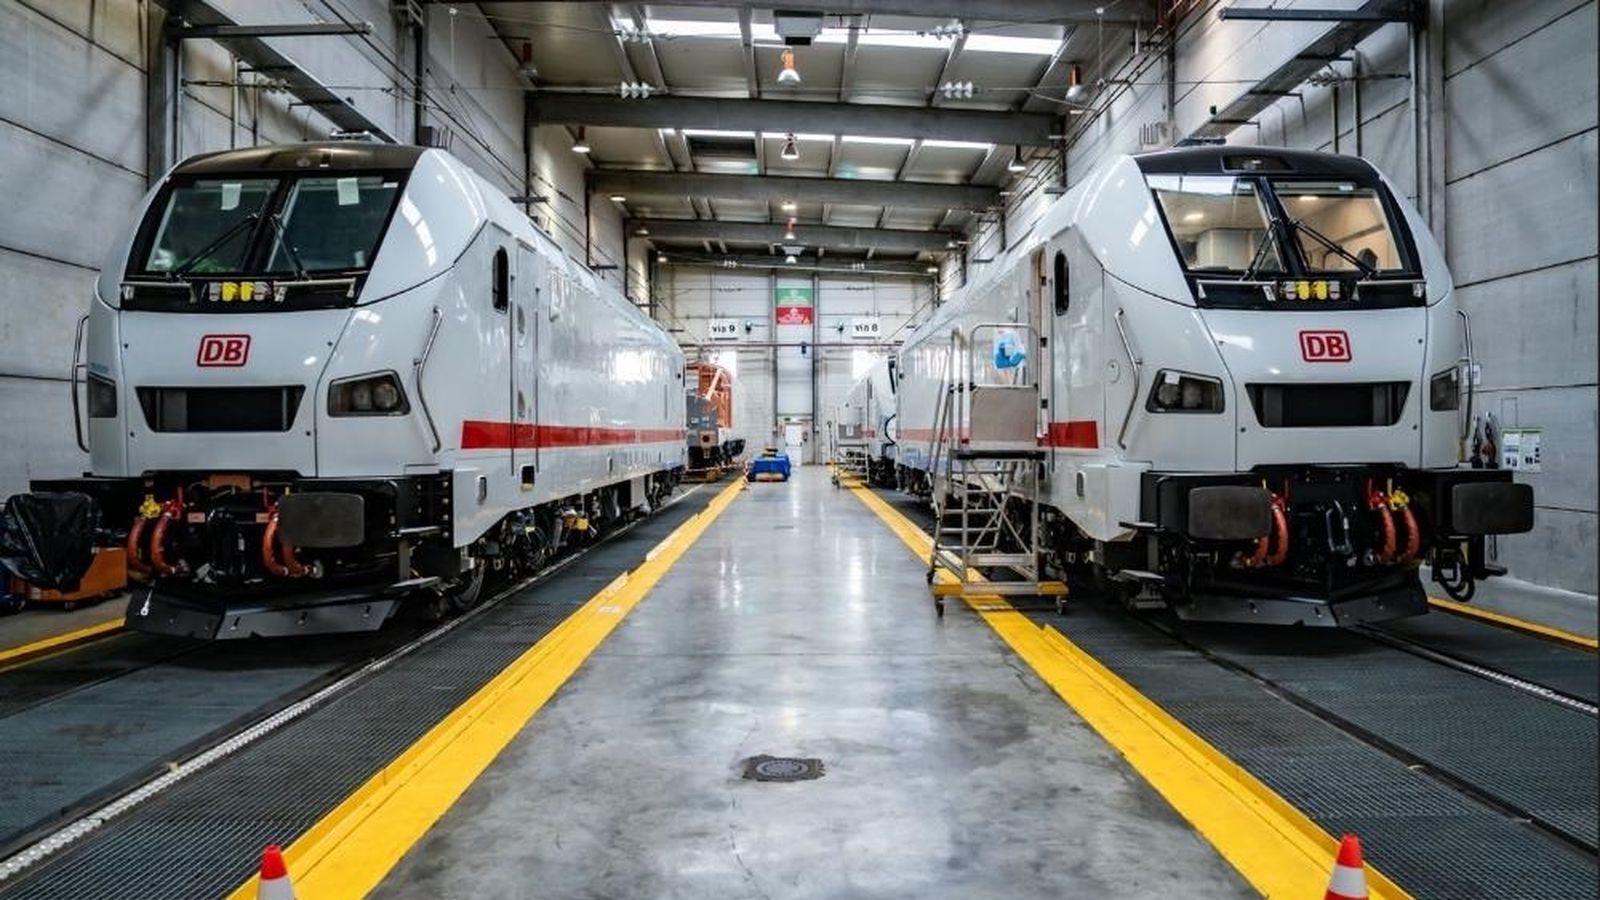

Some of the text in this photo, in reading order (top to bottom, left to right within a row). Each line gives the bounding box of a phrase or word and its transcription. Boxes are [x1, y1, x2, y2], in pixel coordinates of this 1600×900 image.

[728, 324, 736, 334] 9
[871, 323, 878, 333] 8
[203, 339, 244, 362] DB
[1304, 335, 1346, 358] DB
